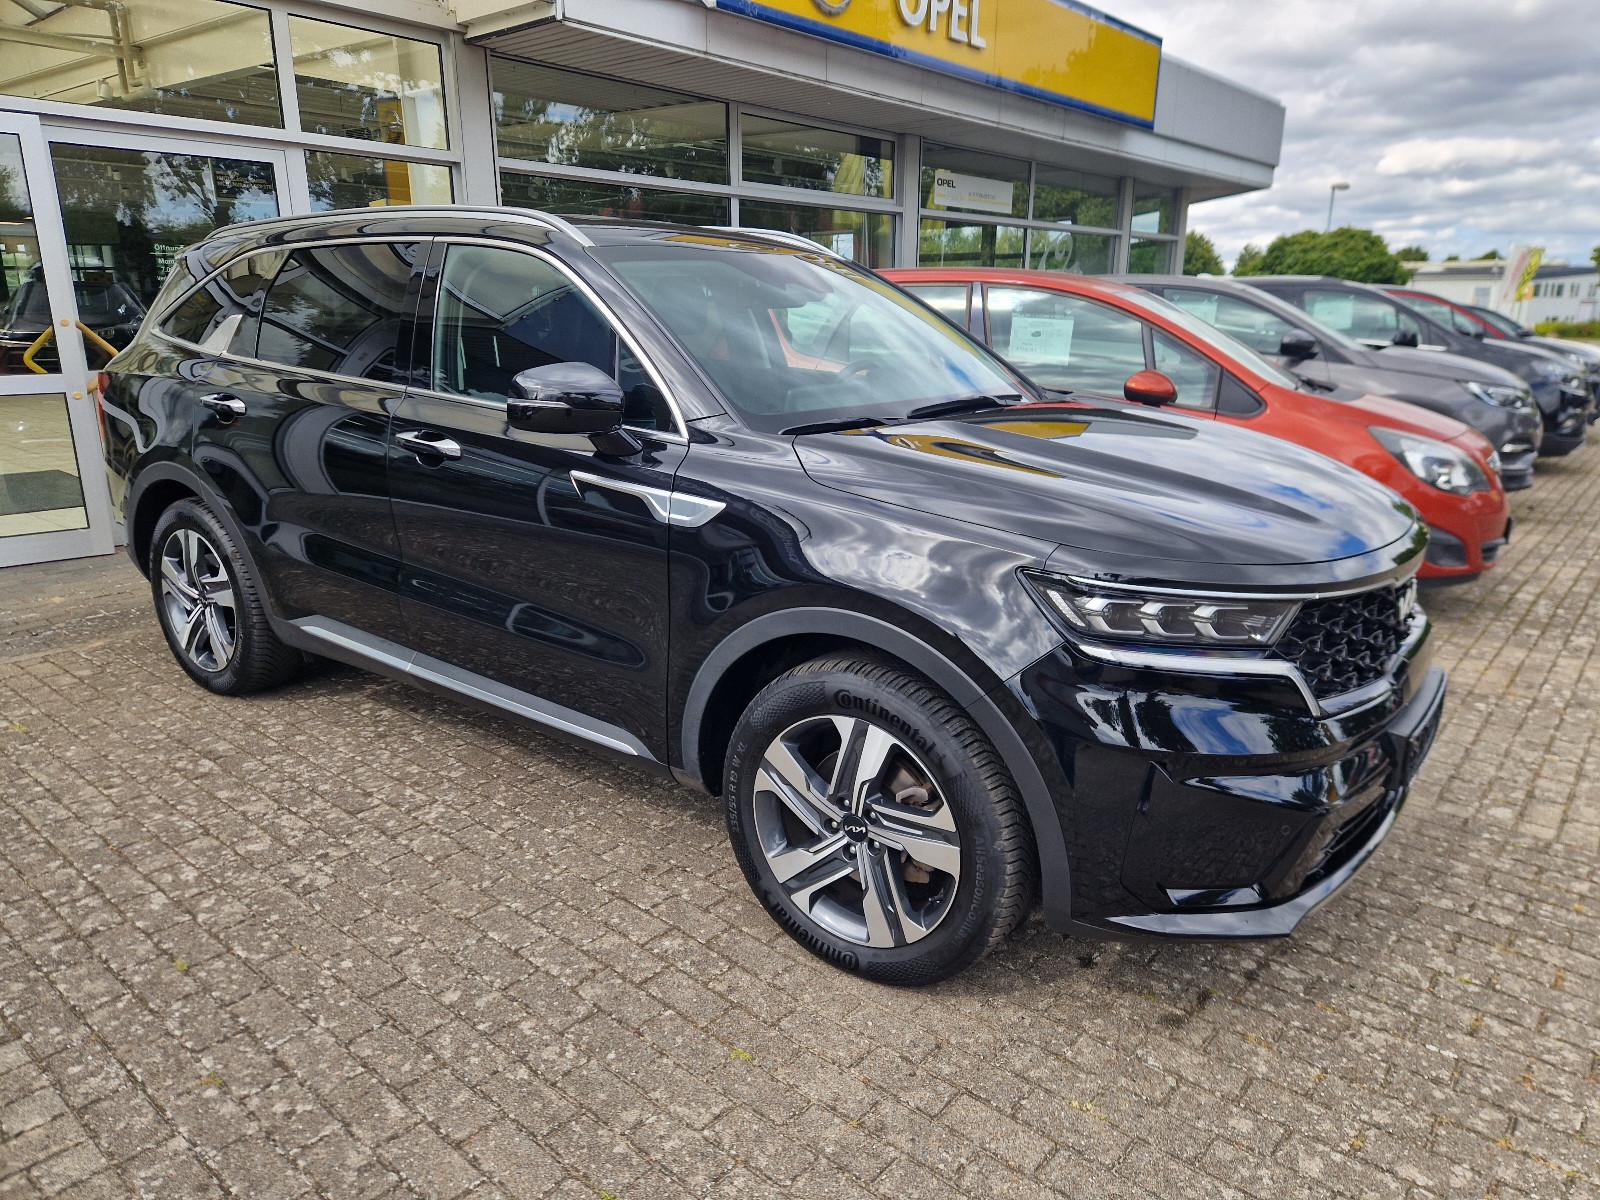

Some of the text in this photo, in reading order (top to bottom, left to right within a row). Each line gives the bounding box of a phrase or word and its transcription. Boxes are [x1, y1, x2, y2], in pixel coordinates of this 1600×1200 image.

[936, 177, 956, 189] OPEL
[833, 688, 938, 754] Continental
[771, 901, 860, 971] Continental
